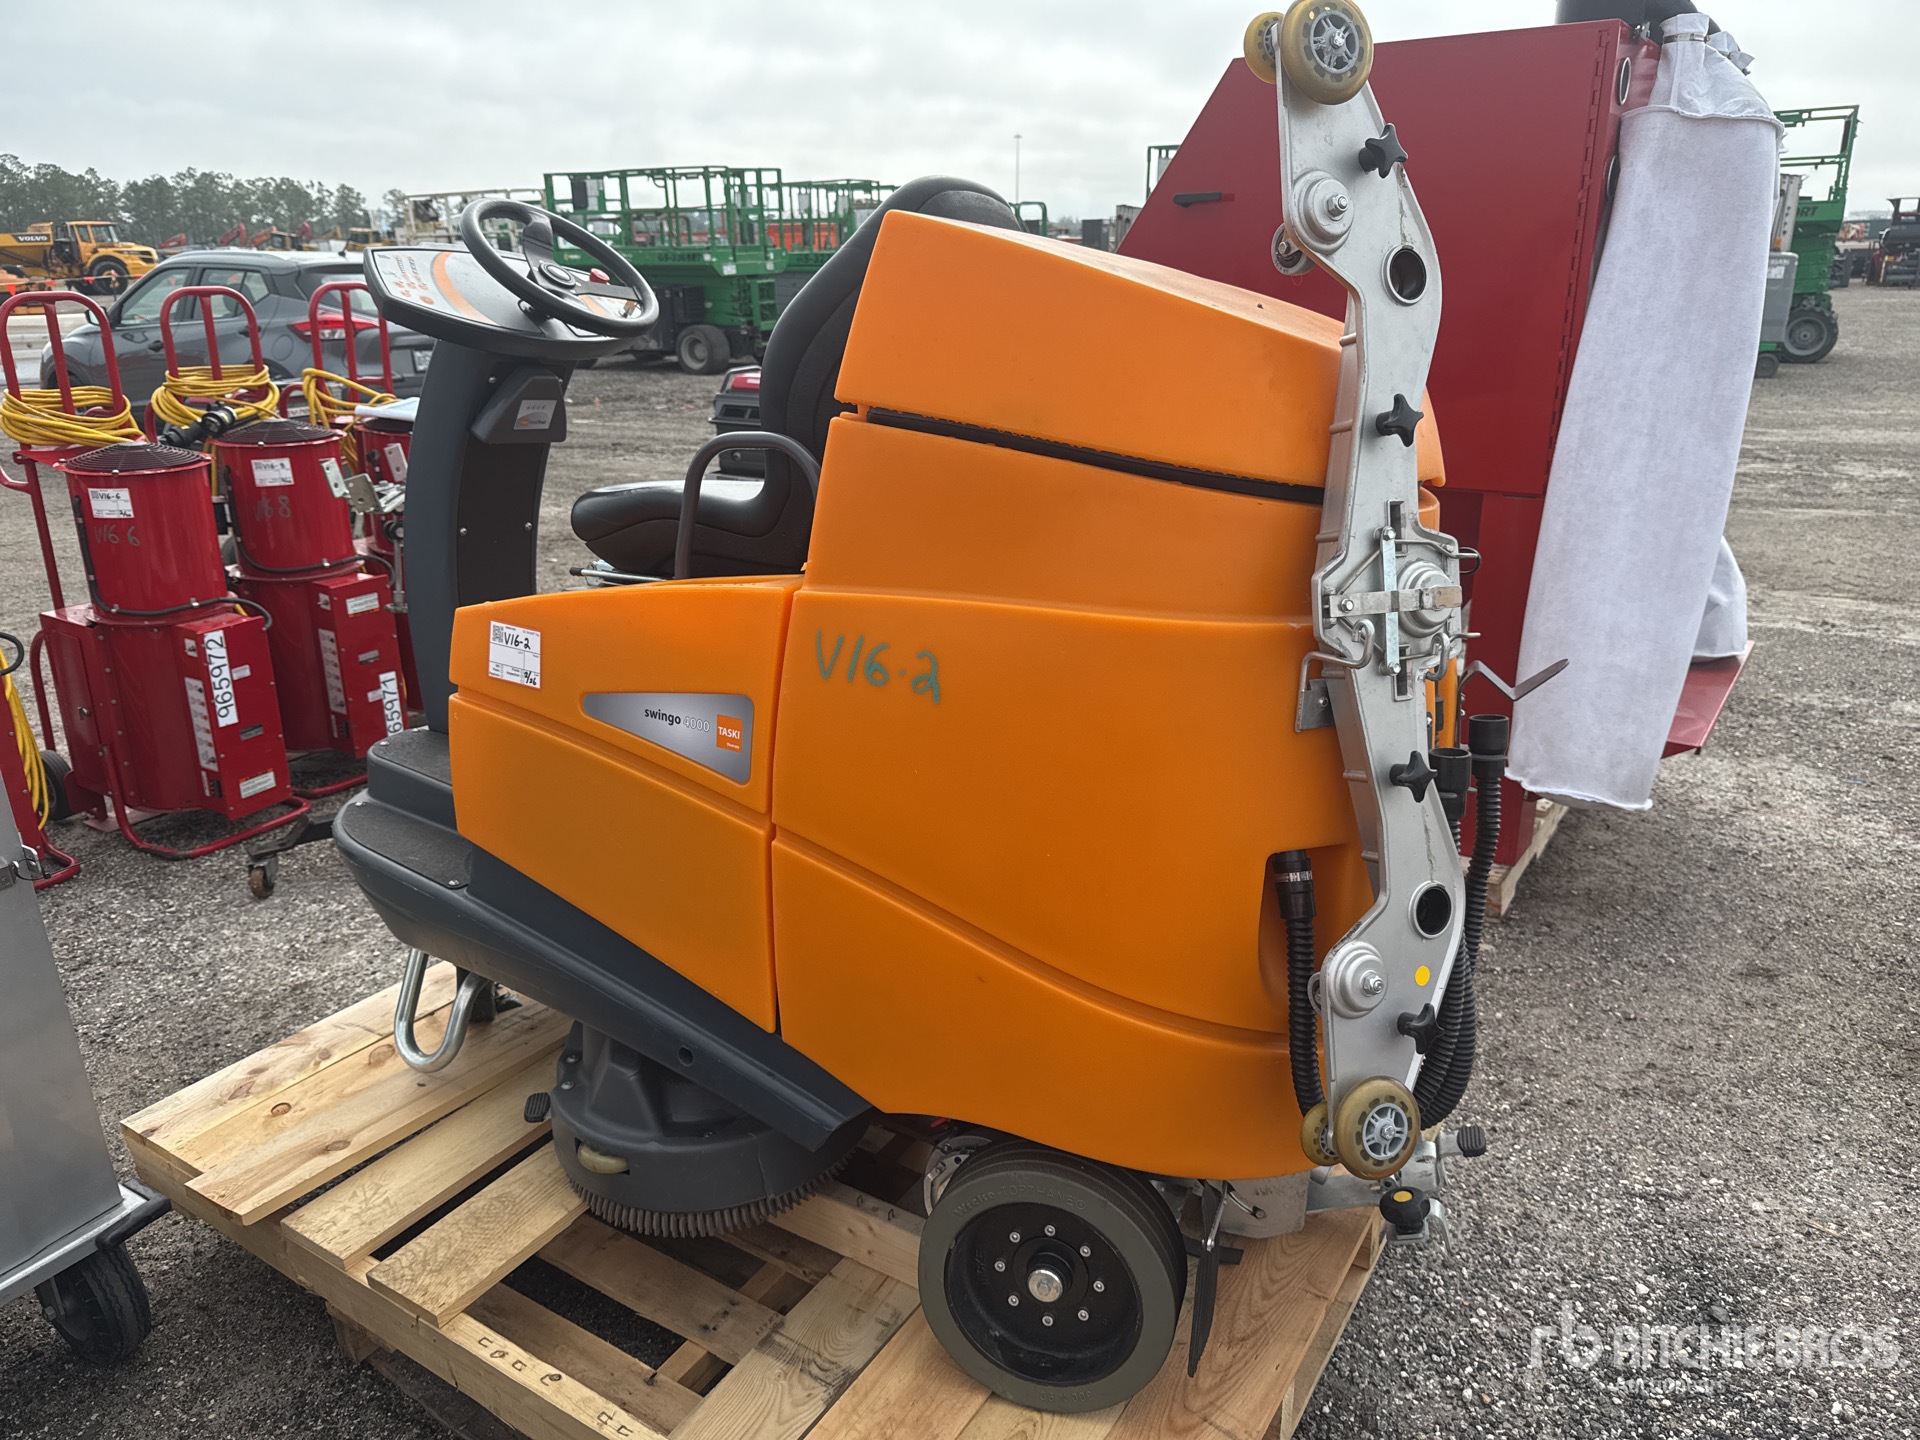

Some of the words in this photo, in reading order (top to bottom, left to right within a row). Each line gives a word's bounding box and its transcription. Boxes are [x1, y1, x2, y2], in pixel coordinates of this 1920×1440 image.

[504, 632, 531, 650] V16-2
[206, 636, 234, 718] 965972
[644, 708, 682, 726] swingo
[683, 716, 710, 733] 4000
[717, 726, 740, 740] TASKI
